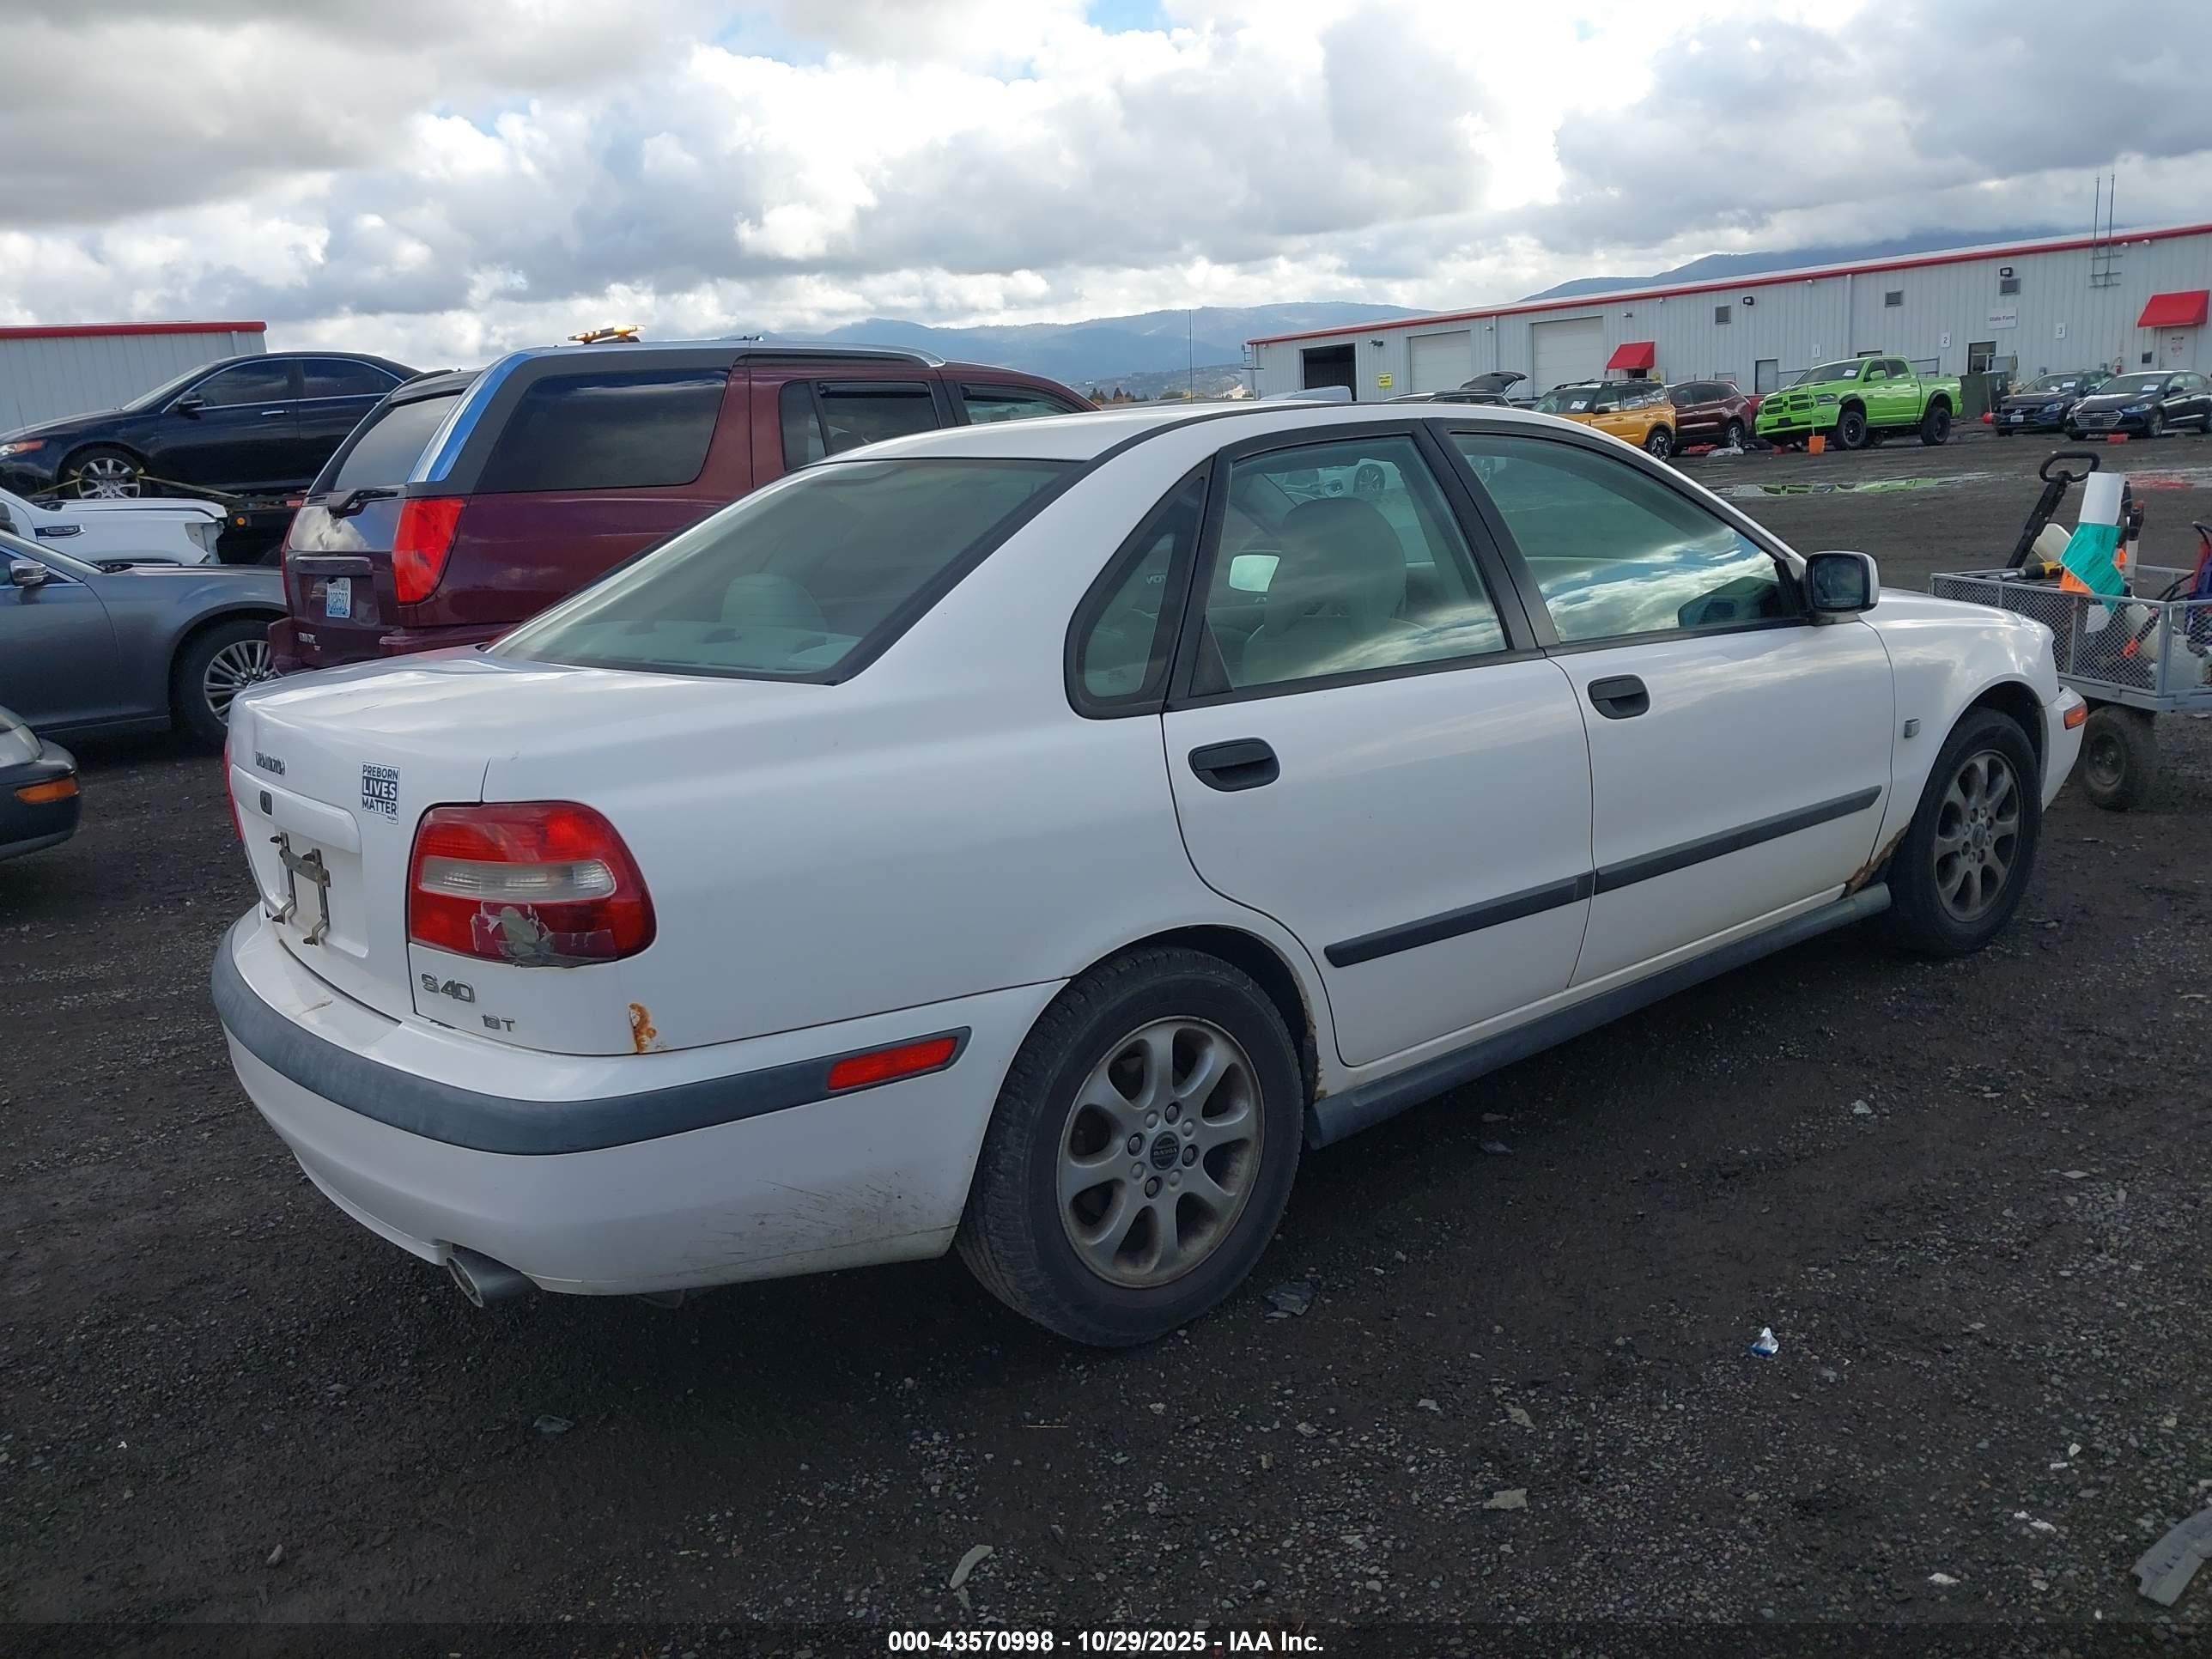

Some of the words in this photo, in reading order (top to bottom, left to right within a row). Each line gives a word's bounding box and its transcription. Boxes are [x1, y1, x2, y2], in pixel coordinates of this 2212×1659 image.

[362, 764, 399, 781] PREBORN
[363, 778, 397, 799] LIVES
[362, 796, 398, 816] MATTER
[421, 971, 476, 1004] S40
